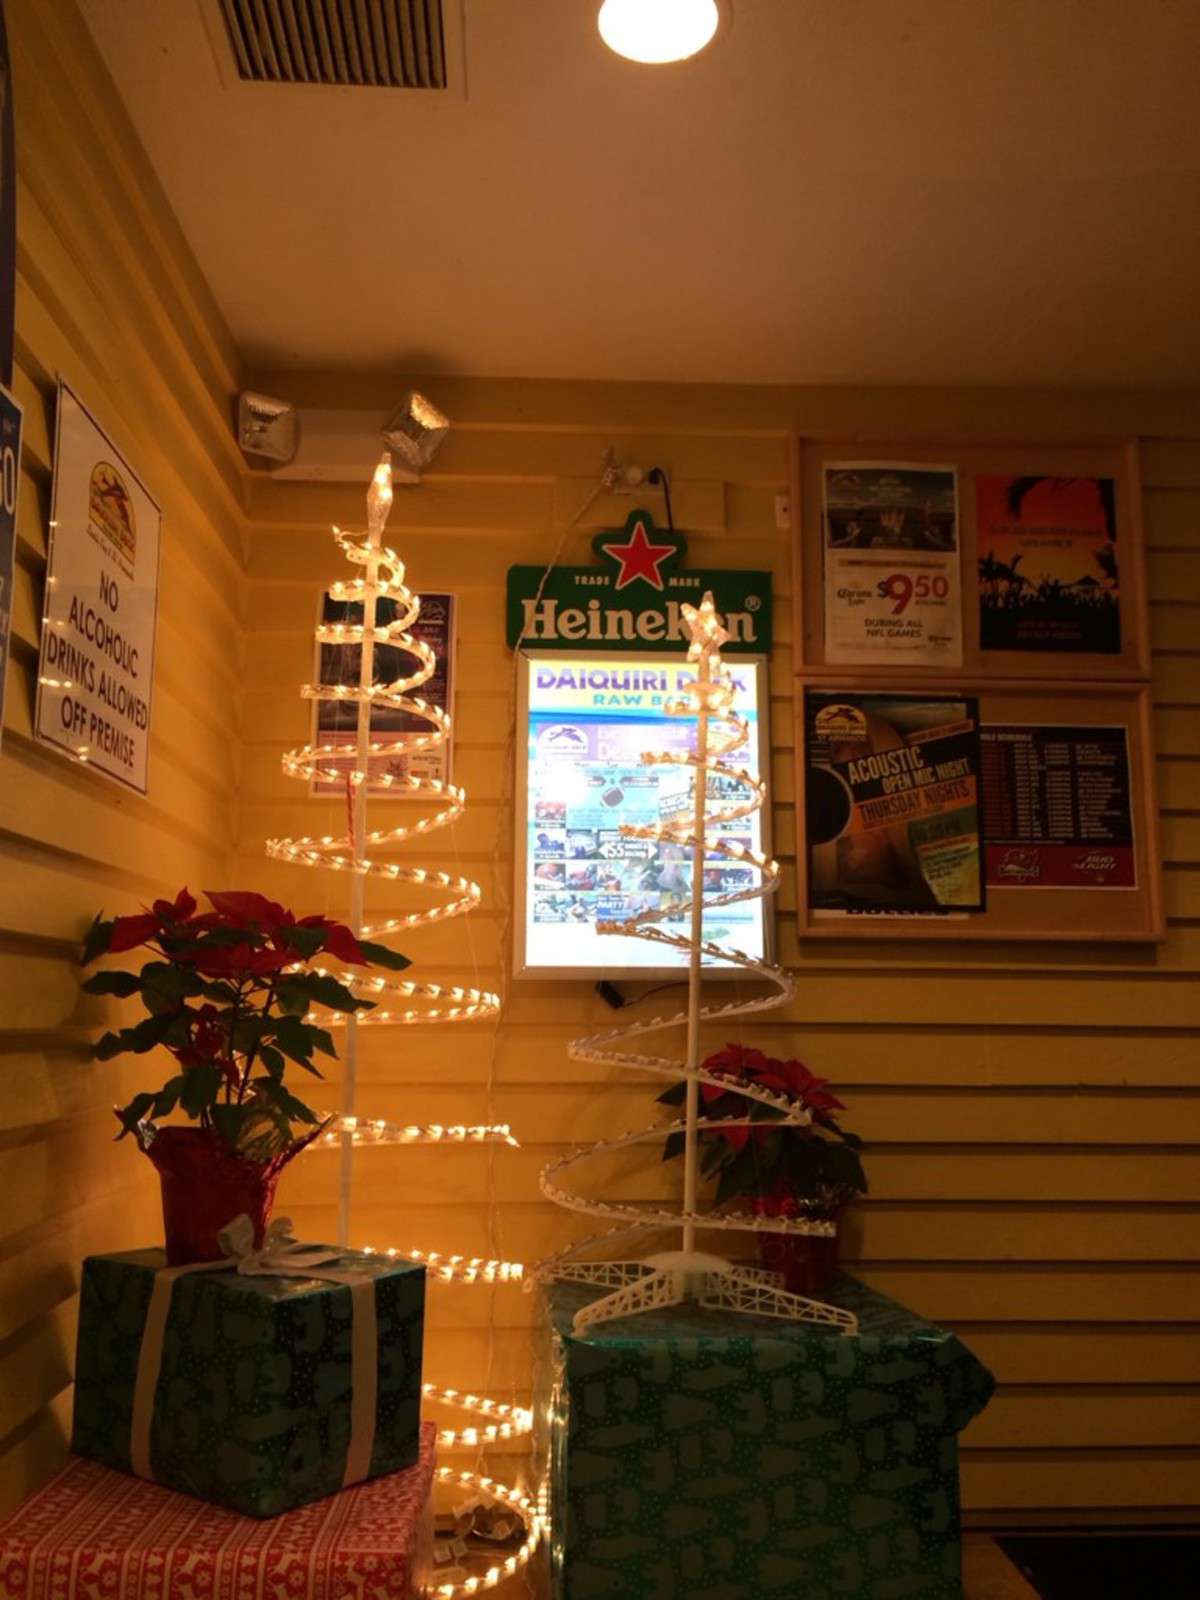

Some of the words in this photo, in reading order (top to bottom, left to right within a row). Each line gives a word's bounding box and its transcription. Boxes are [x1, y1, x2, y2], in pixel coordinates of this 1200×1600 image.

[100, 569, 119, 613] NO
[574, 575, 610, 585] TRADE
[668, 577, 701, 587] MARK
[69, 595, 138, 679] ALCOHOLIC
[521, 599, 757, 643] Heinekn
[864, 618, 904, 628] DURING
[906, 619, 923, 628] ALL
[866, 629, 885, 638] NFL
[888, 629, 922, 638] GAMES
[48, 631, 95, 693] DRINKS
[98, 671, 148, 731] ALLOWED
[537, 667, 668, 691] DAIQUIRI
[676, 671, 747, 692] DK
[592, 694, 643, 706] RAW
[61, 695, 87, 736] OFF
[90, 712, 135, 769] PREMISE
[847, 746, 924, 785] ACOUSTIC
[881, 773, 914, 794] OPEN
[913, 766, 936, 786] MIC
[935, 758, 969, 781] NIGHT
[859, 791, 922, 824] THURSDAY
[924, 781, 970, 806] NIGHTS
